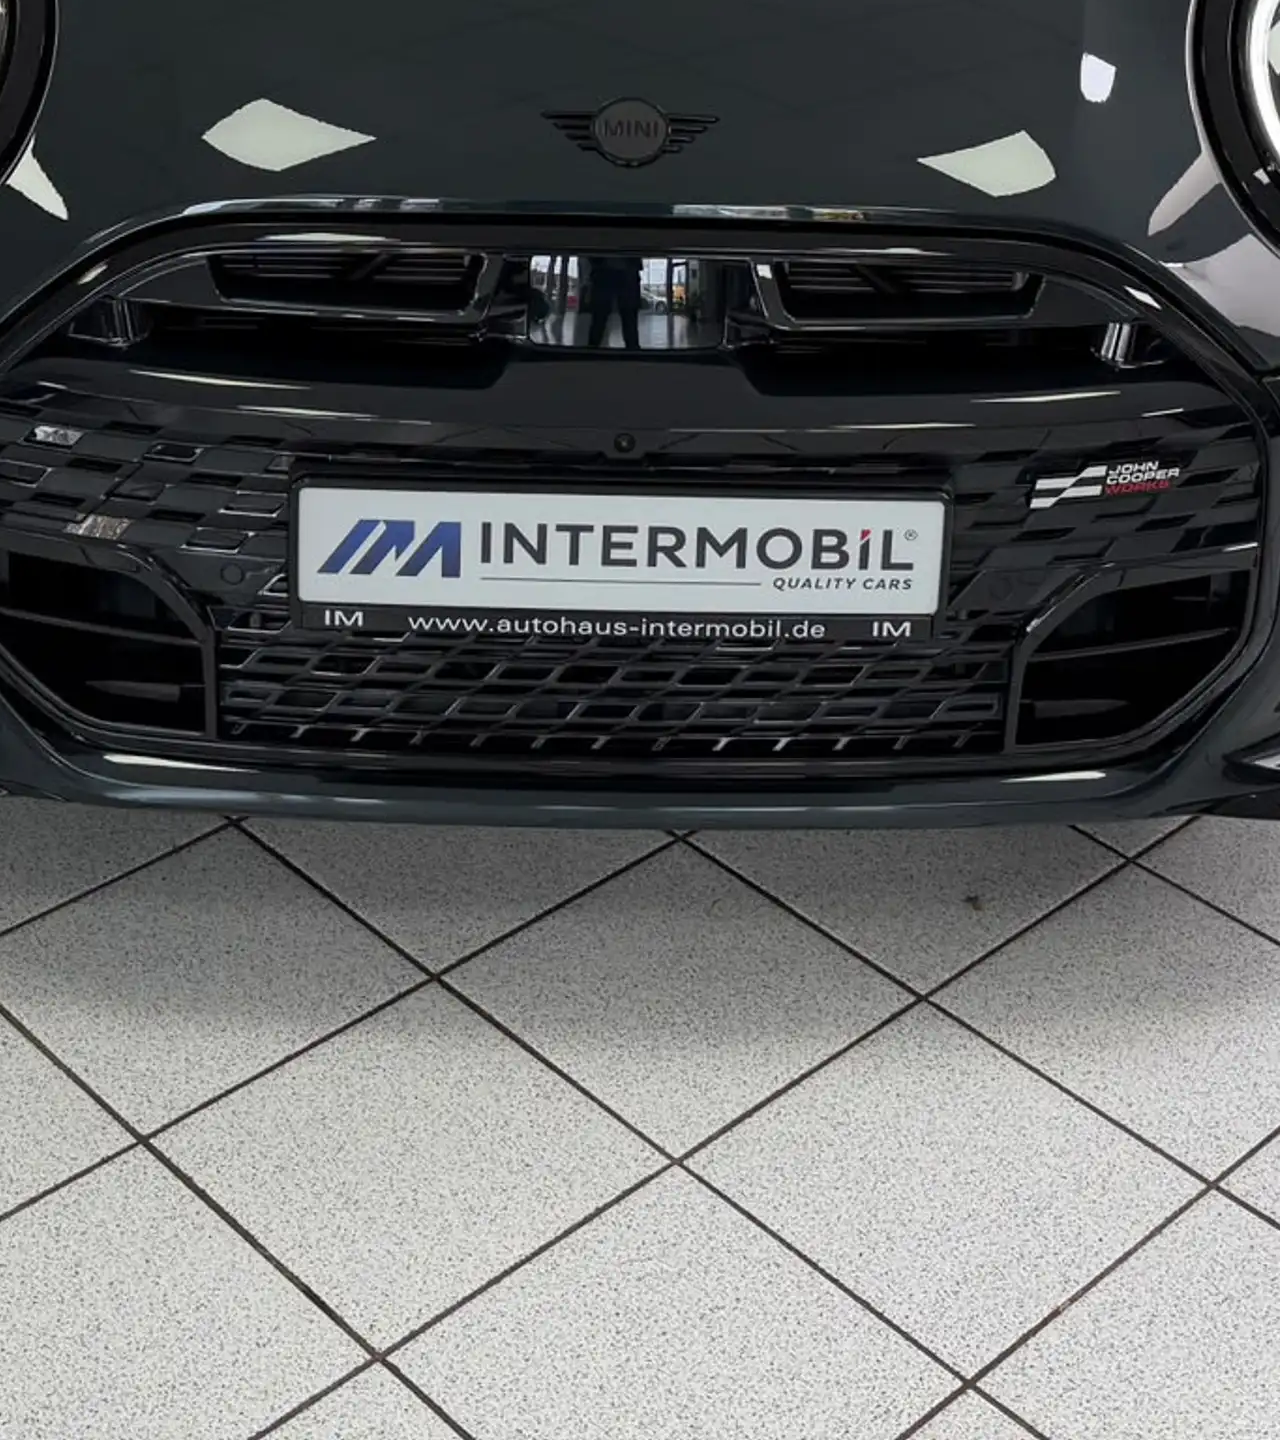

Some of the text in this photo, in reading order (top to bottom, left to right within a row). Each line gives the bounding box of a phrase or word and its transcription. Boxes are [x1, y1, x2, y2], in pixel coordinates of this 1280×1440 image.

[604, 119, 659, 138] MINI
[1106, 467, 1180, 485] COOPER
[1108, 461, 1159, 476] JOHN
[1105, 481, 1169, 495] WORKS
[772, 576, 913, 592] QUALITY CARS
[324, 610, 911, 639] IM www.autohaus-intermobil.de IM
